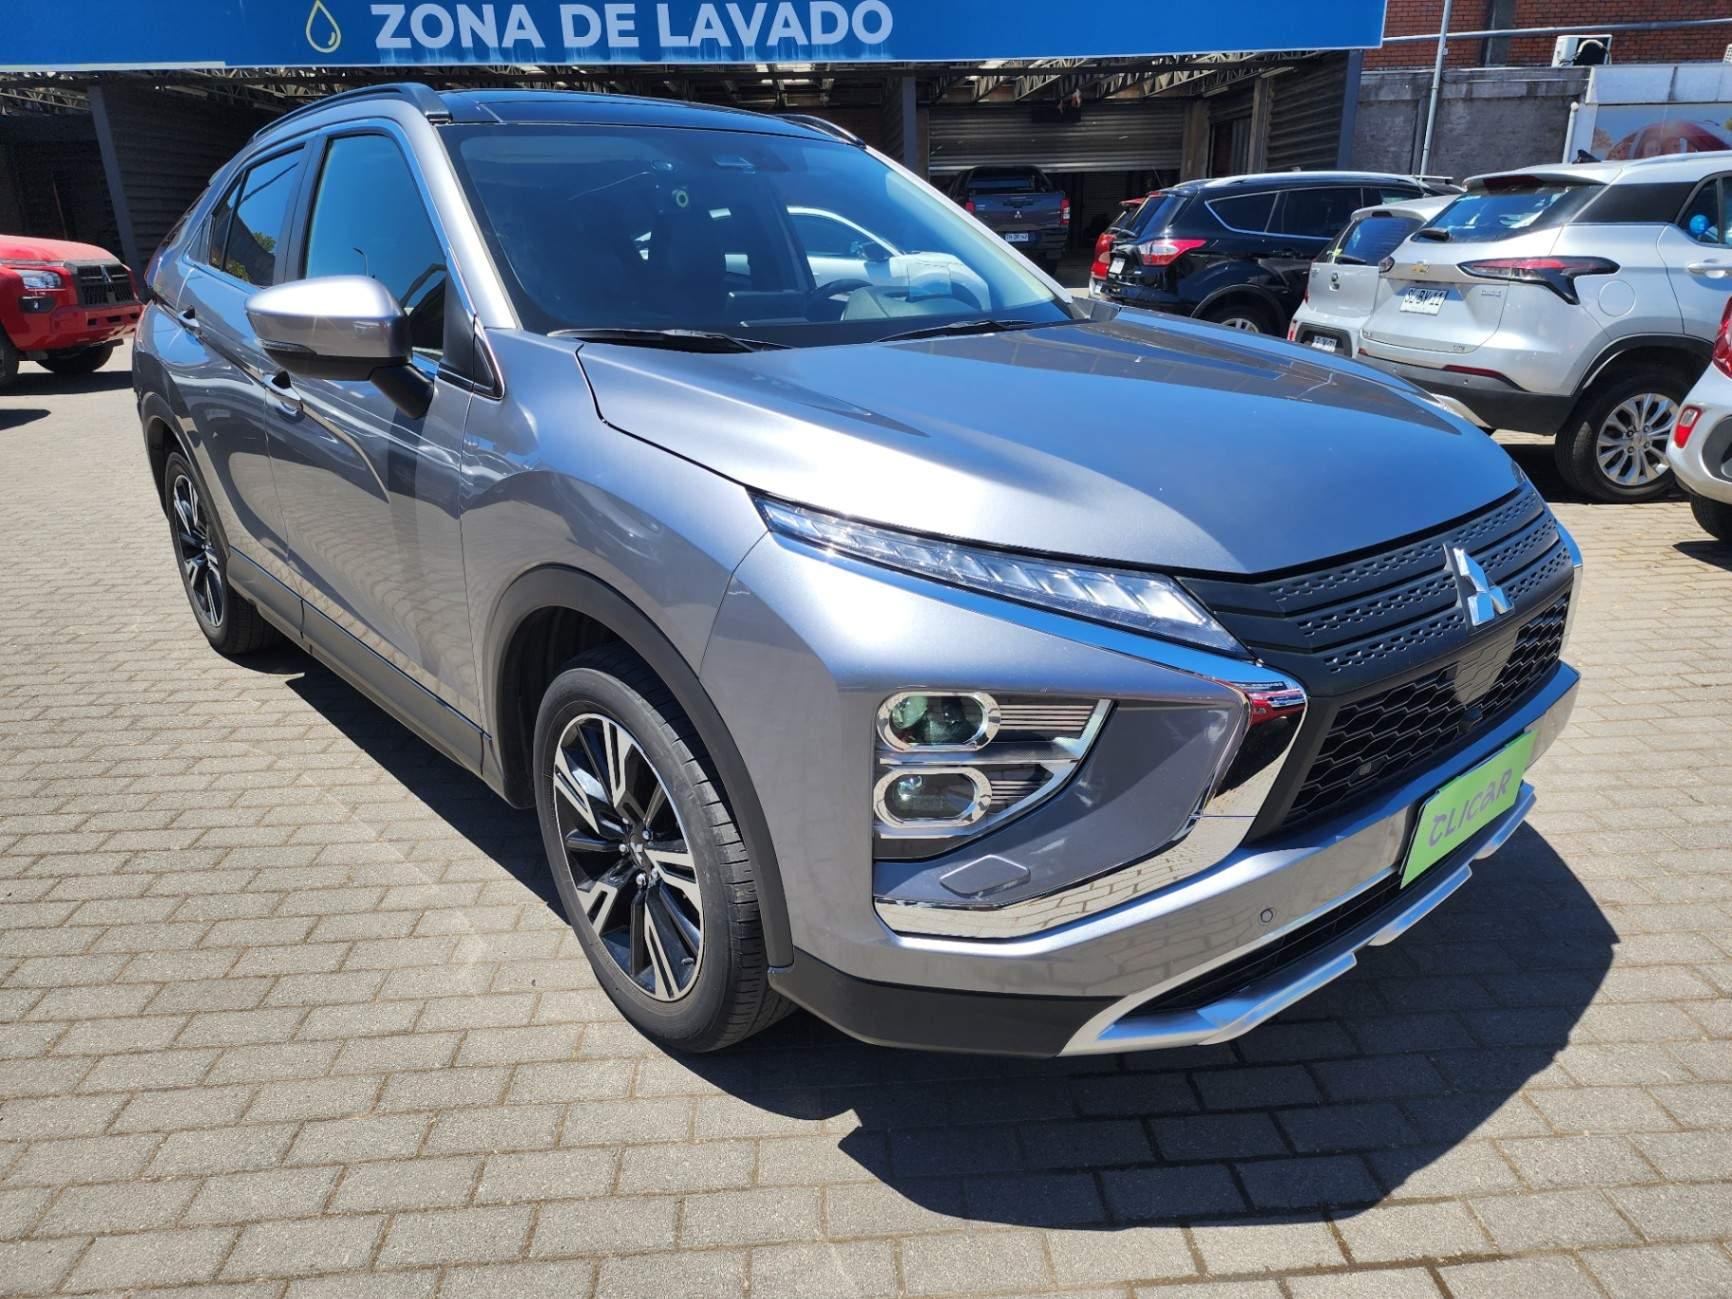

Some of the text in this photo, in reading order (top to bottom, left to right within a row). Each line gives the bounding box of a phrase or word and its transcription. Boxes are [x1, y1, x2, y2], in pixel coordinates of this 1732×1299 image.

[370, 0, 894, 49] ZONA DE LAVADO
